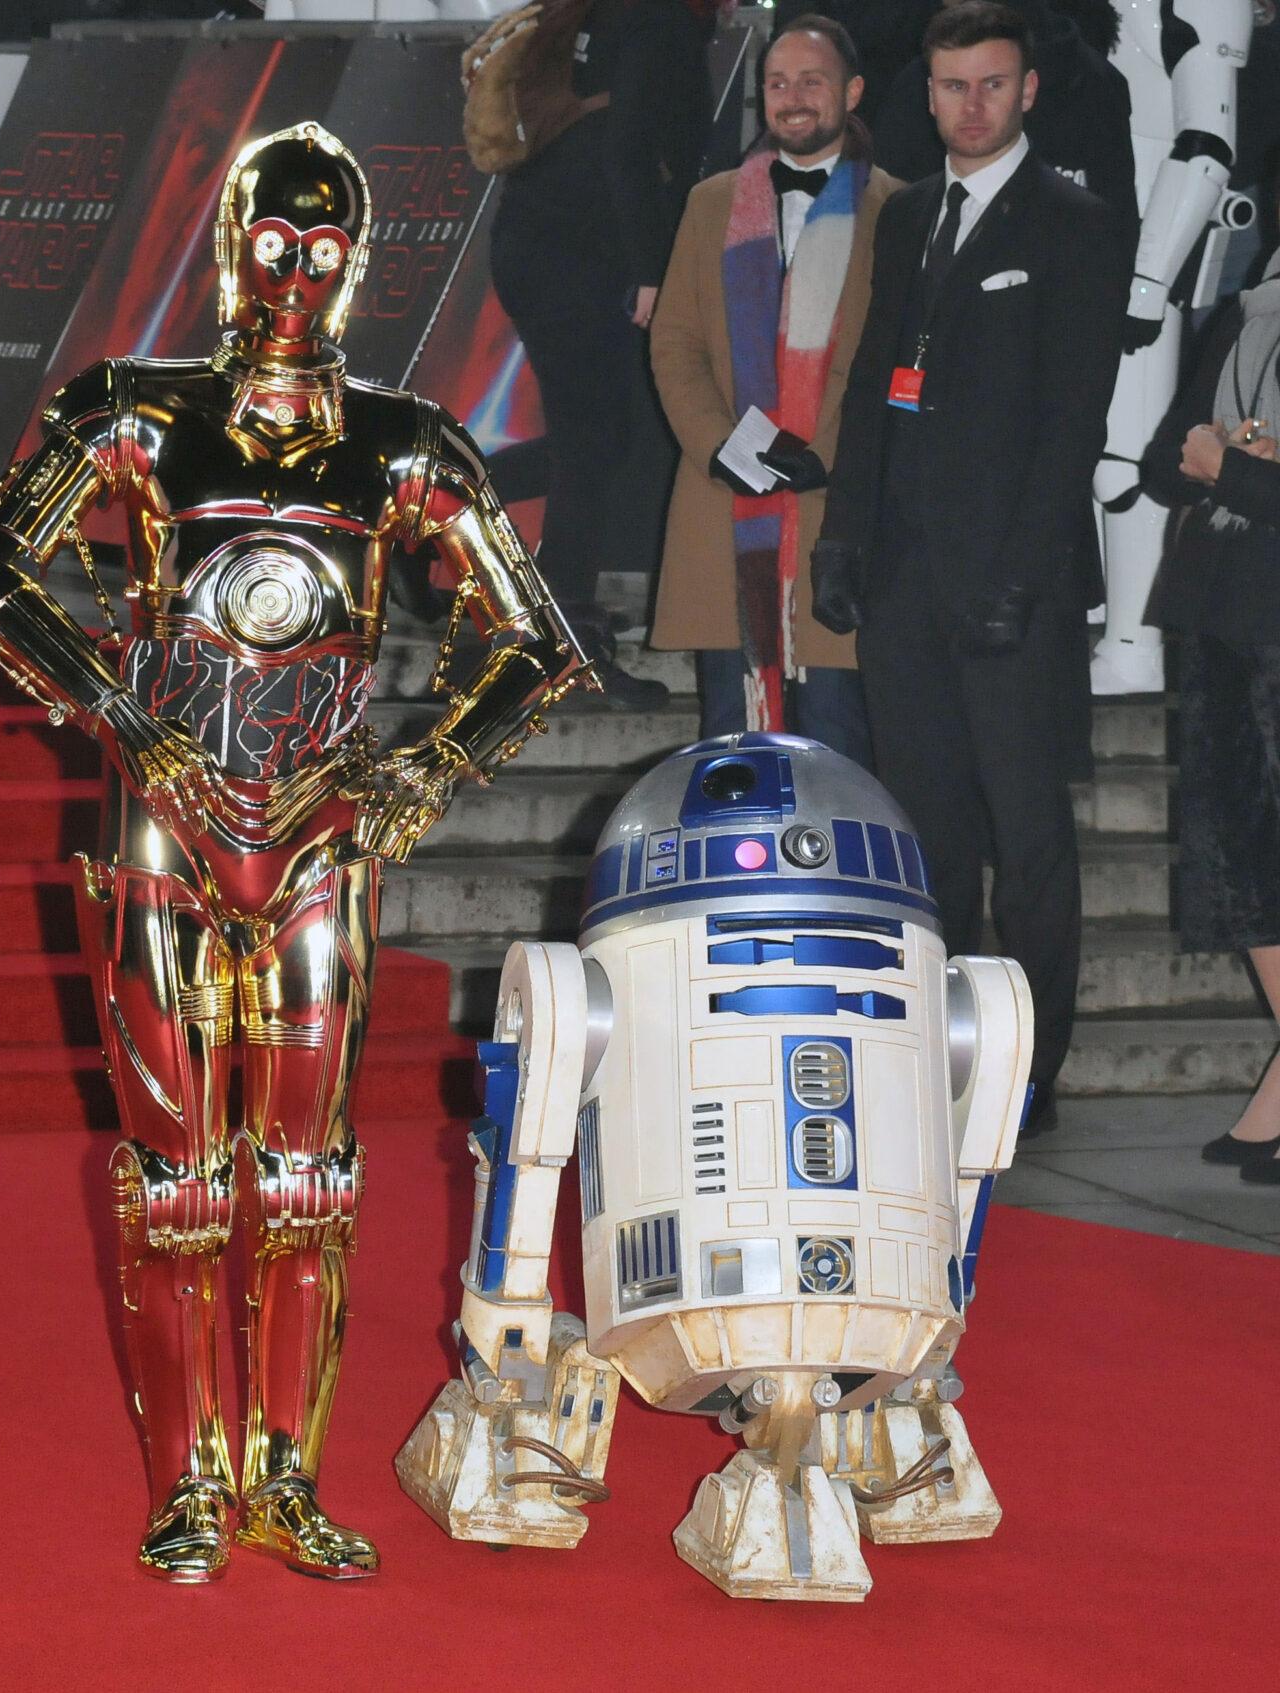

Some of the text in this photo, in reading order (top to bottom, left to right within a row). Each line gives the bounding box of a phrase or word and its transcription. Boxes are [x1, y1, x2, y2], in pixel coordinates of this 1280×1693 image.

[20, 201, 66, 219] LAST
[73, 203, 115, 221] JEDI
[370, 221, 465, 242] AST JEDI
